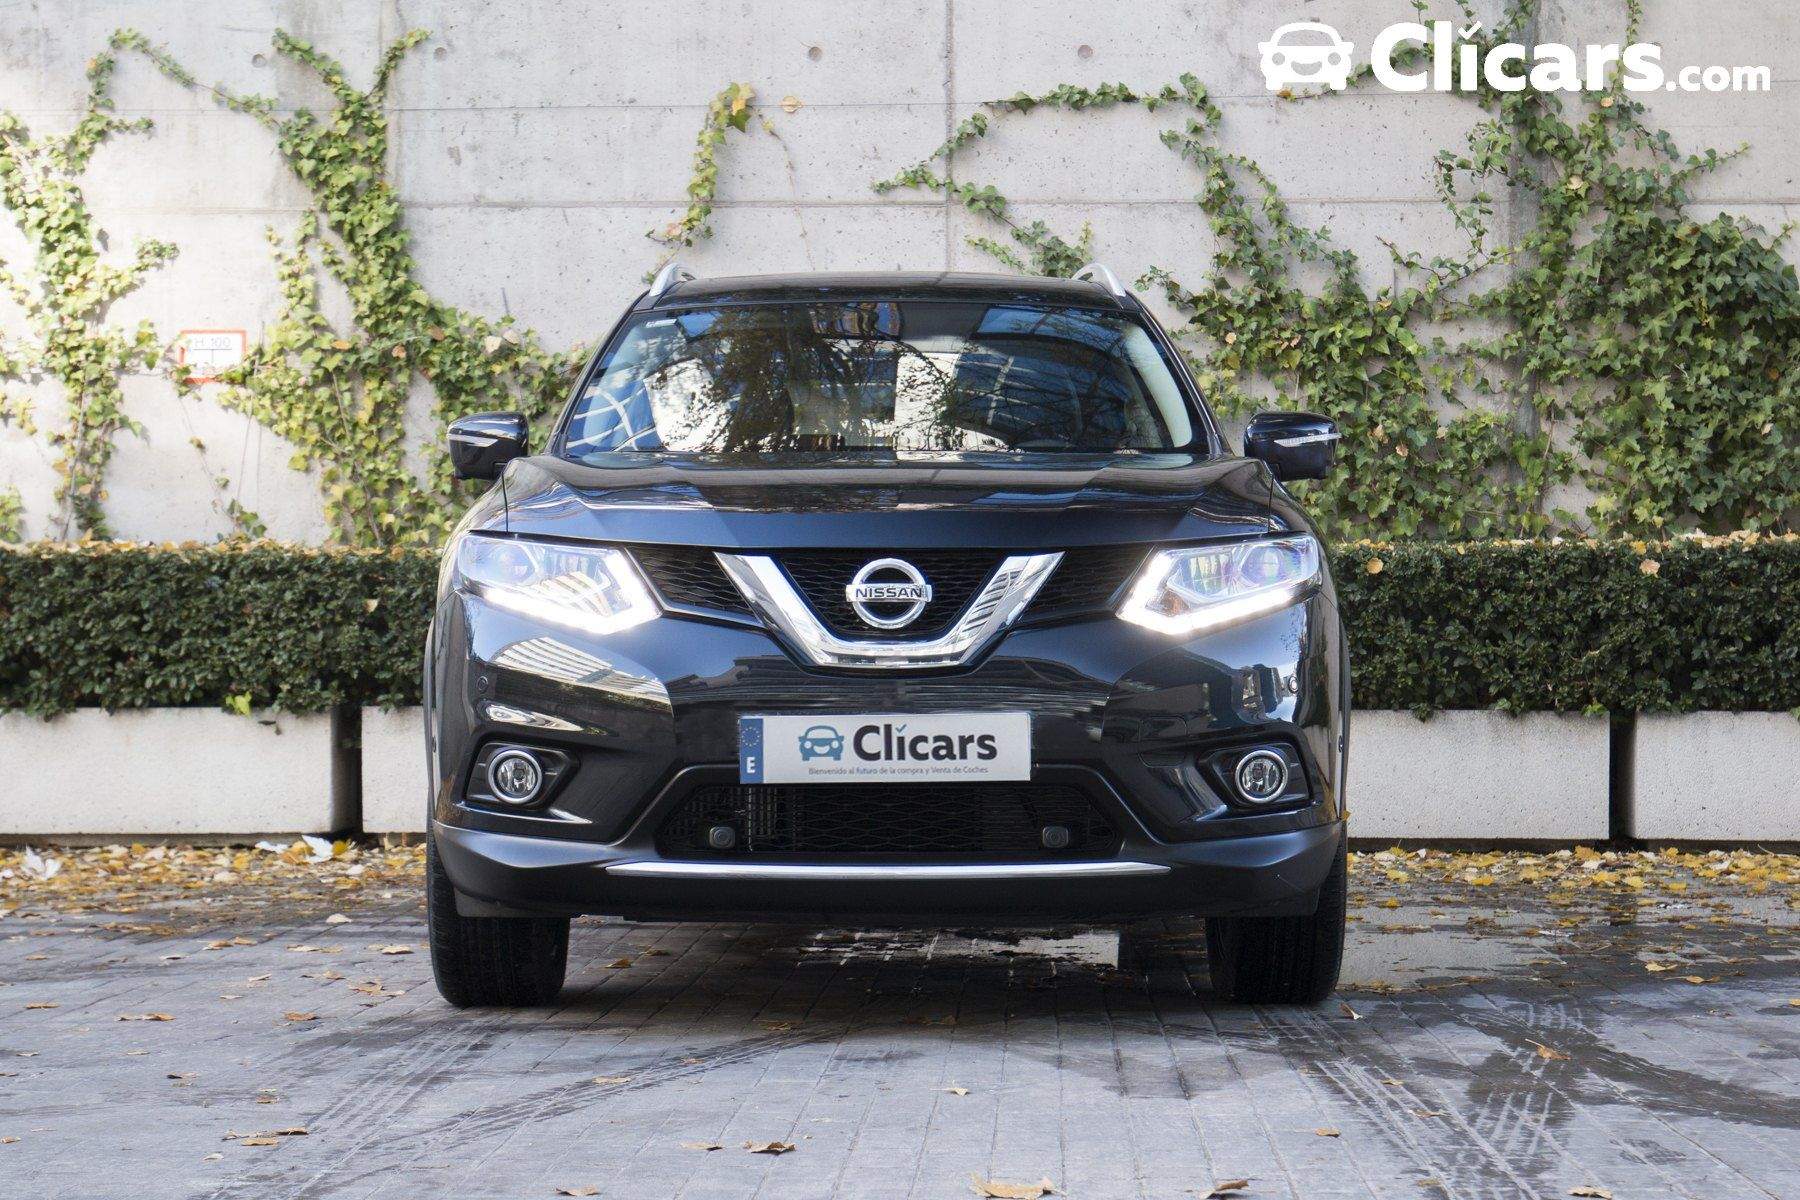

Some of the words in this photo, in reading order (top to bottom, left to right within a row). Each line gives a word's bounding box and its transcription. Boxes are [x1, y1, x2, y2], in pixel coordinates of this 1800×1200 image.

[855, 587, 922, 598] NISSAN
[853, 724, 998, 761] Clicars
[746, 756, 756, 774] E
[808, 767, 848, 775] Bienvenido
[857, 766, 878, 774] futuro
[890, 766, 896, 774] la
[931, 766, 951, 774] Venta
[953, 766, 961, 774] de
[963, 766, 988, 774] Coches
